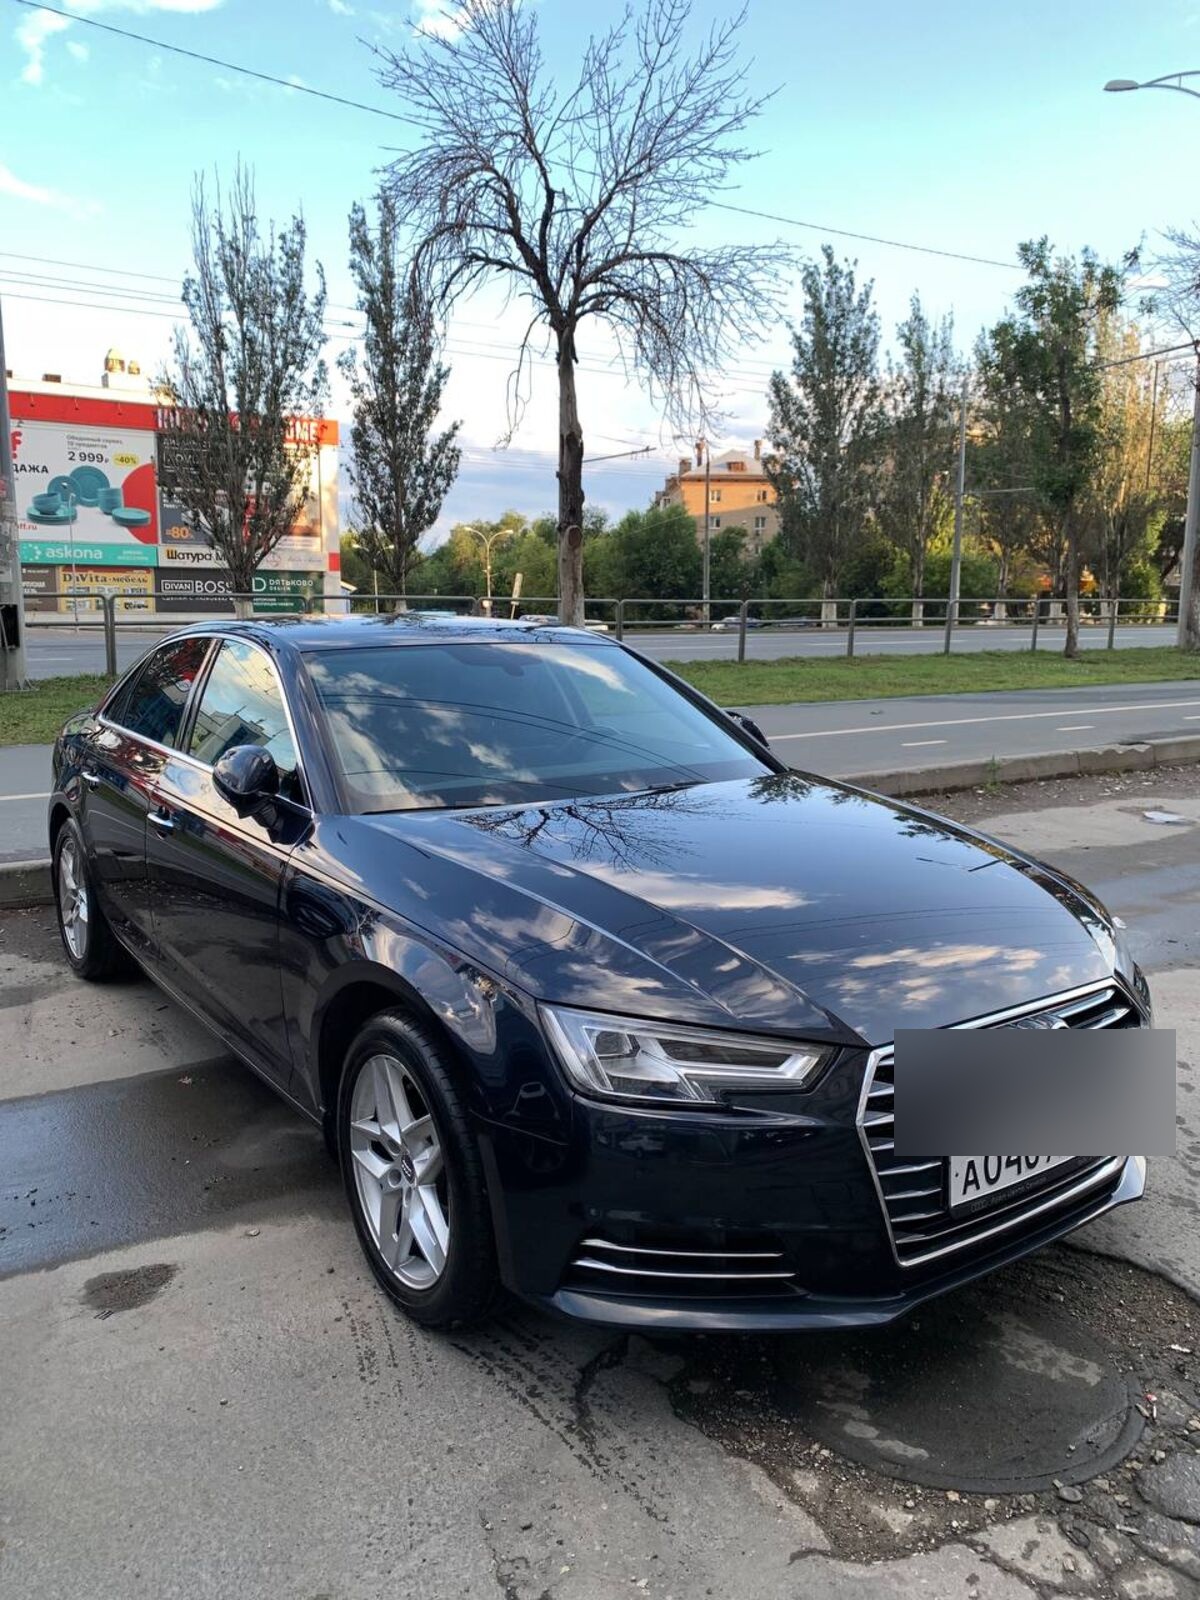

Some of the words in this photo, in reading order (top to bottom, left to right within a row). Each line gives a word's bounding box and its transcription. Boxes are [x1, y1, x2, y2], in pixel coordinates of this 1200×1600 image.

[12, 463, 50, 475] ДАЖА
[46, 545, 103, 560] askona
[166, 549, 212, 563] Шатура
[164, 582, 191, 590] DIVAN
